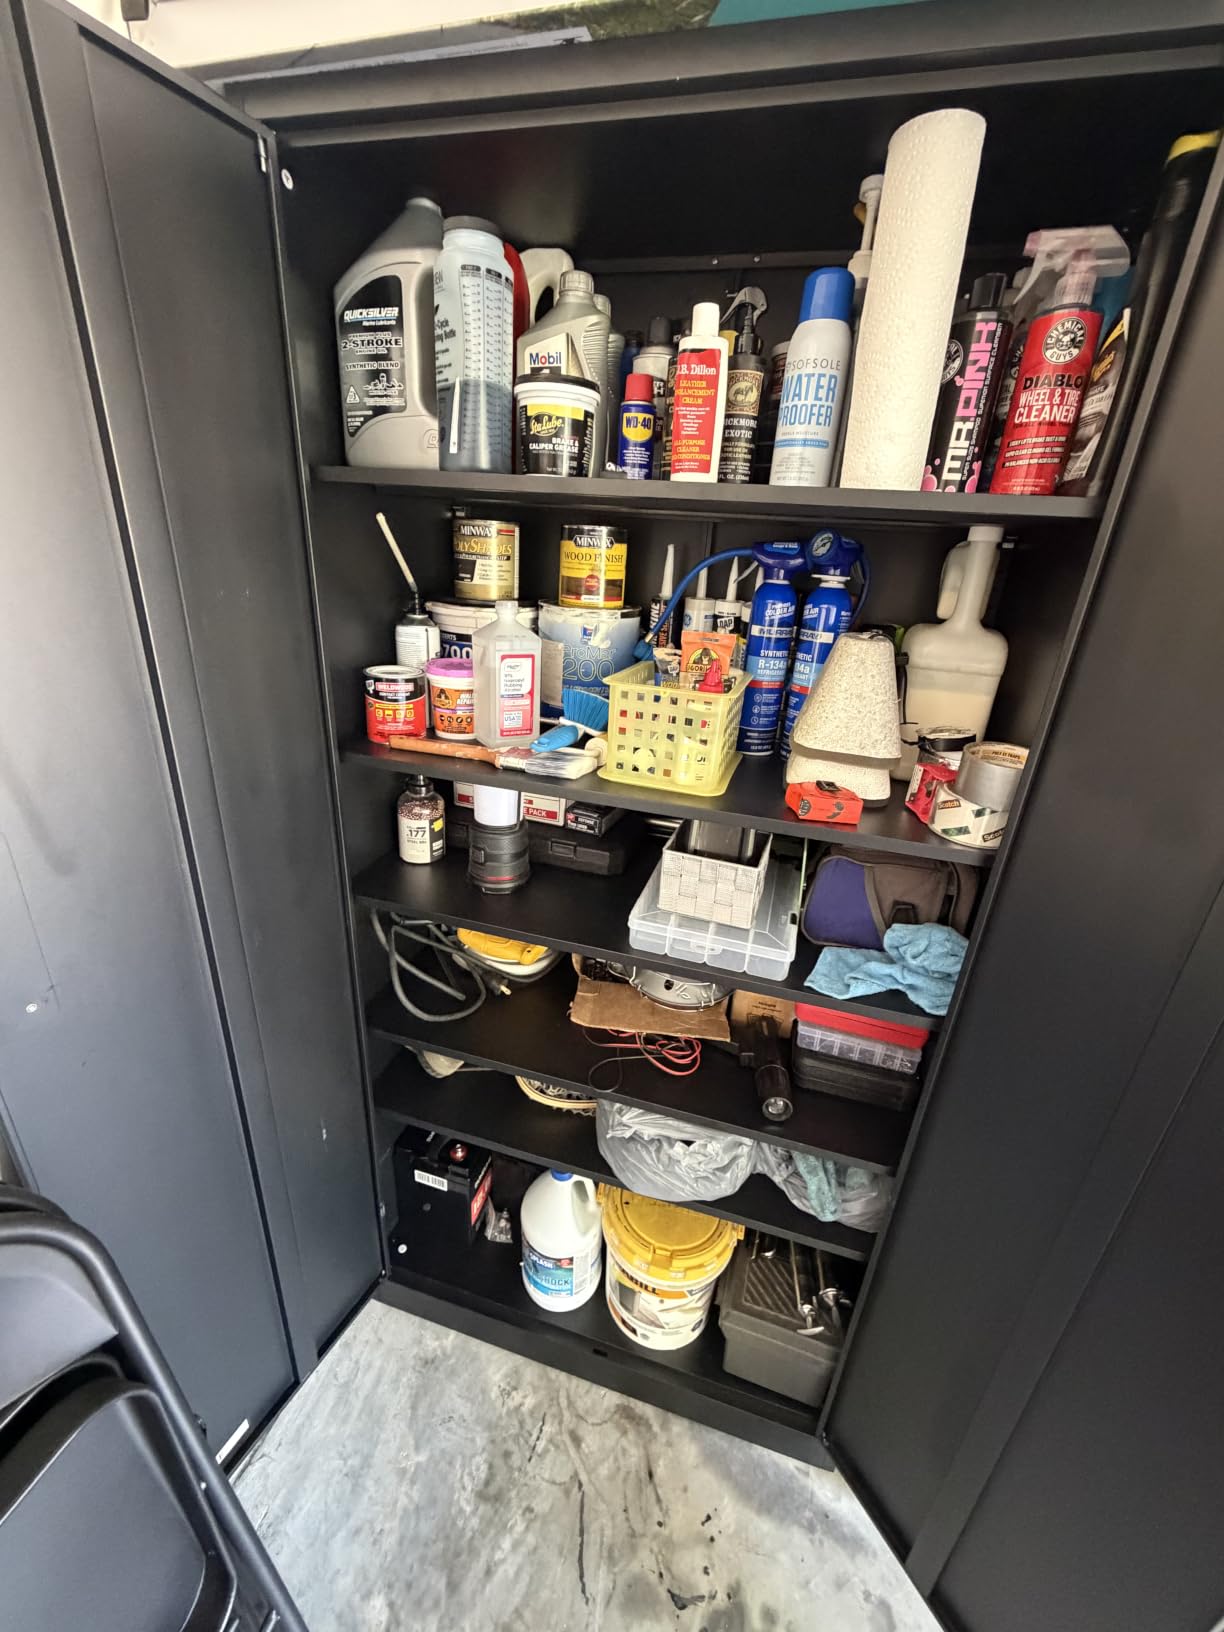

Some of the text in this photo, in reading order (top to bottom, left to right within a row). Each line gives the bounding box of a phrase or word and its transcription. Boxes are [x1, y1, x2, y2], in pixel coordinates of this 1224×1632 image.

[344, 307, 399, 322] QUICKSILVER
[1046, 320, 1086, 346] CHEMICAL
[341, 337, 403, 350] 2-STROKE
[529, 351, 562, 366] Mobil
[1050, 350, 1074, 363] GUYS
[345, 361, 401, 370] SYNTHETIC BLEND
[690, 363, 717, 376] Dillon
[781, 372, 838, 404] WATER
[1023, 373, 1085, 391] DIABLO
[675, 388, 715, 397] NHANCEMENT
[1018, 389, 1050, 408] WHEEL
[1053, 389, 1062, 405] &
[1062, 389, 1081, 407] TIRE
[1014, 405, 1077, 424] CLEANER
[725, 429, 753, 439] EXOTIC
[576, 536, 612, 548] MINWX
[564, 551, 592, 562] WOOD
[563, 657, 614, 681] 200
[939, 801, 959, 809] Scotch
[529, 808, 547, 817] PACK
[406, 829, 427, 838] .177
